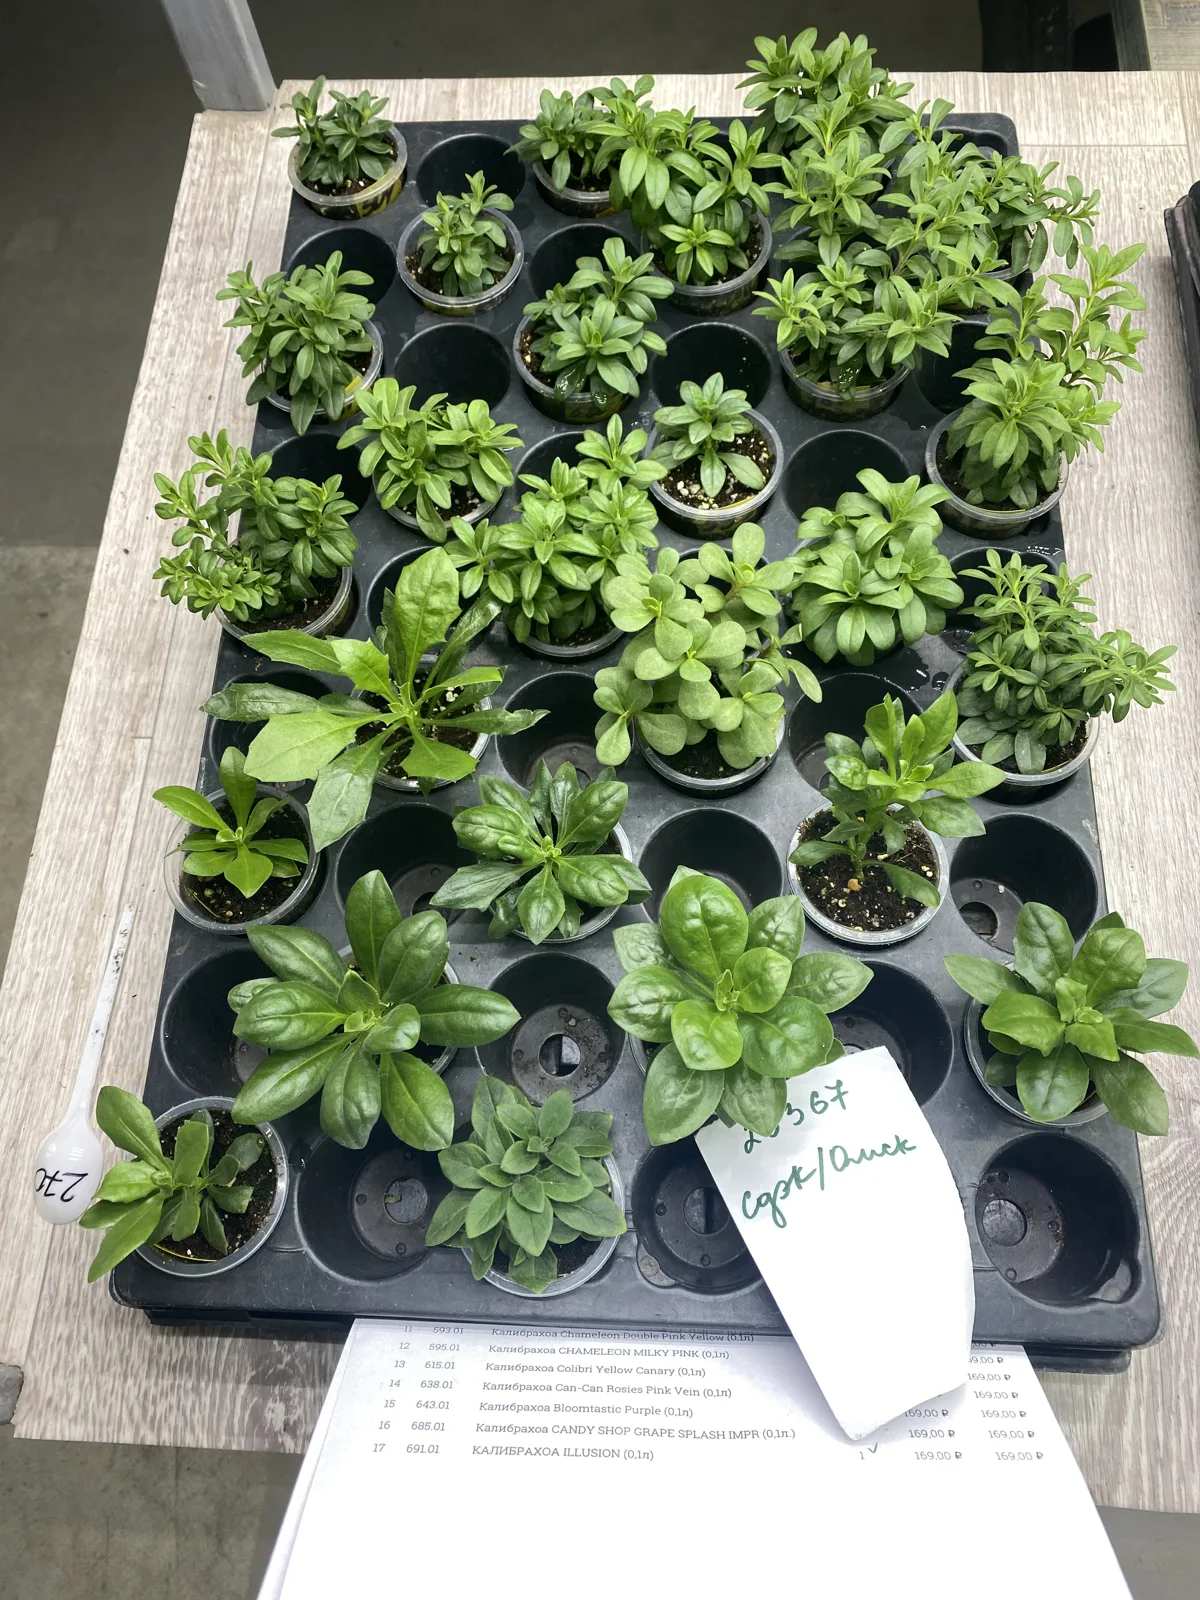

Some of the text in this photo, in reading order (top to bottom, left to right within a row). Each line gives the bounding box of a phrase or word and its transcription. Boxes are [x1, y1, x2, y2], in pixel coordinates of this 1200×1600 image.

[744, 1079, 849, 1154] 2367
[433, 1326, 463, 1335] 593.01
[492, 1328, 558, 1338] Калибрахоа
[560, 1330, 620, 1339] Chameleon
[623, 1331, 660, 1340] Double
[662, 1332, 686, 1341] Pink
[689, 1332, 724, 1342] Yellow
[399, 1342, 410, 1350] 12
[429, 1343, 460, 1351] 595.01
[489, 1345, 555, 1355] Калибрахоа
[558, 1347, 631, 1356] CHAMELEON
[672, 1348, 700, 1358] PINK
[394, 1360, 405, 1368] 13
[425, 1361, 456, 1369] 615.01
[486, 1363, 554, 1373] Калибрахоа
[557, 1365, 592, 1373] Colibri
[596, 1366, 633, 1374] Yellow
[636, 1367, 675, 1376] Canary
[389, 1379, 400, 1387] 14
[421, 1380, 453, 1389] 638.01
[483, 1382, 552, 1392] Калибрахоа
[555, 1384, 603, 1392] Can-Can
[607, 1385, 643, 1394] Rosies
[646, 1386, 671, 1394] Pink
[674, 1387, 700, 1396] Vein
[973, 1391, 1008, 1399] 169,00
[384, 1399, 396, 1408] 15
[416, 1400, 450, 1409] 643.01
[479, 1402, 550, 1413] Калибрахоа
[553, 1403, 621, 1413] Bloomtastic
[624, 1406, 661, 1416] Purple
[981, 1410, 1016, 1418] 169,00
[379, 1421, 391, 1429] 16
[411, 1421, 445, 1431] 685.01
[476, 1423, 548, 1435] Калибрахоа
[551, 1425, 594, 1434] CANDY
[597, 1426, 631, 1435] SHOP
[634, 1427, 675, 1438] GRAPE
[677, 1429, 726, 1439] SPLASH
[729, 1430, 760, 1439] IMPR
[909, 1429, 945, 1439] 169,00
[988, 1430, 1024, 1439] 169,00
[373, 1443, 386, 1452] 17
[407, 1444, 440, 1454] 691.01
[472, 1446, 559, 1456] КАЛИБРАХОА
[562, 1448, 620, 1458] ILLUSION
[914, 1451, 951, 1460] 169,00
[995, 1452, 1032, 1461] 169,00
